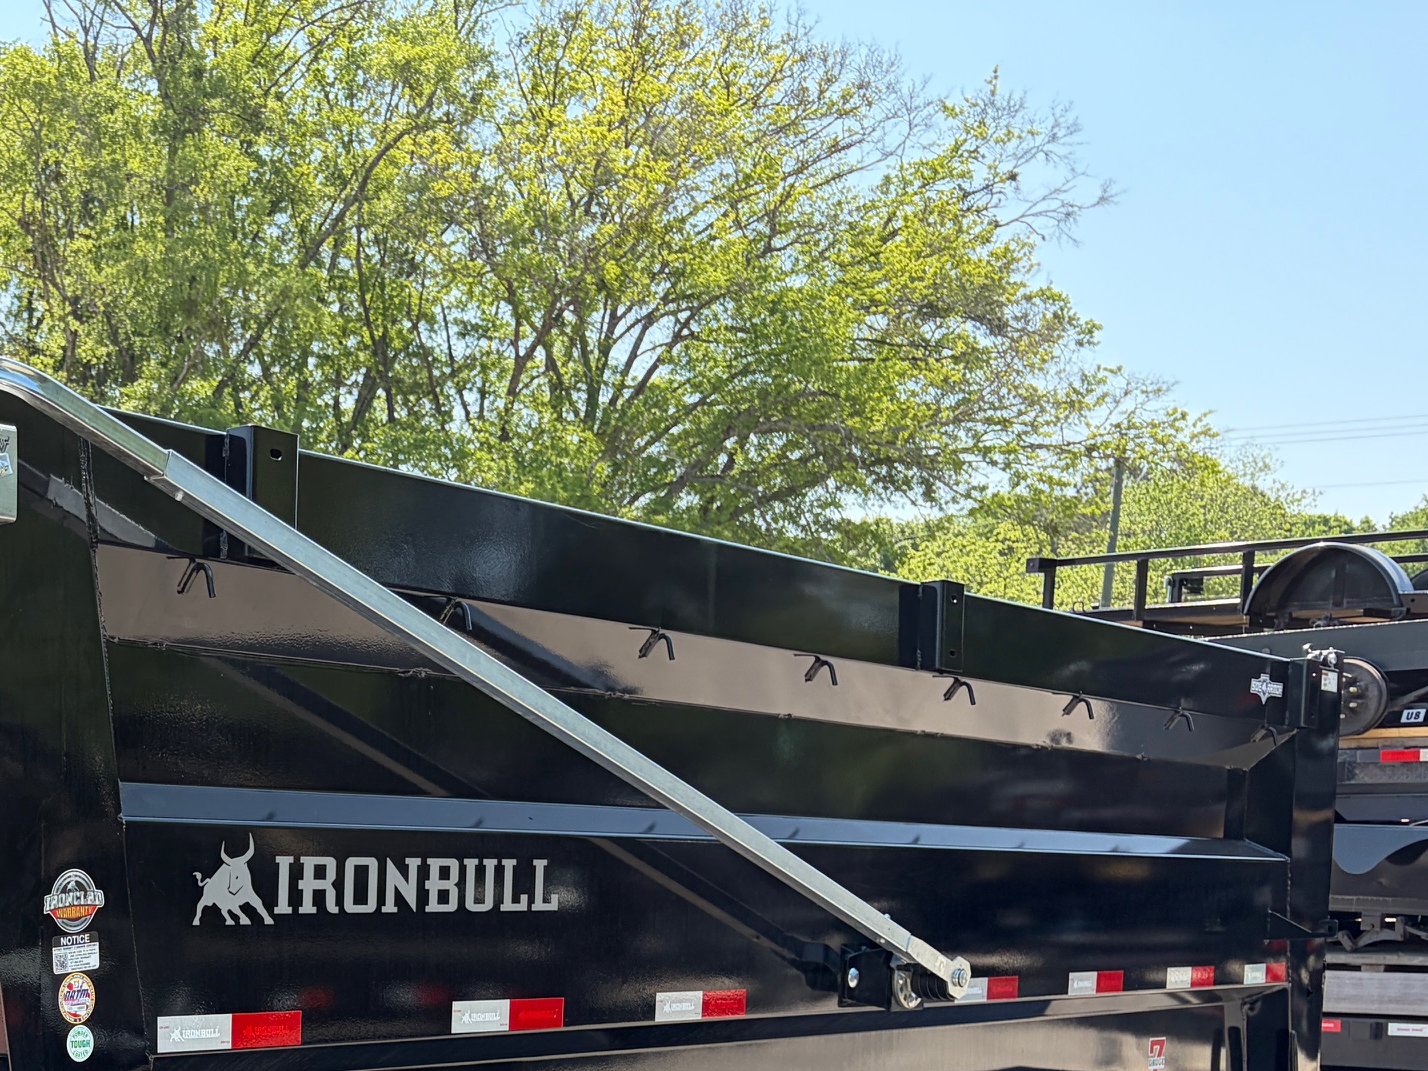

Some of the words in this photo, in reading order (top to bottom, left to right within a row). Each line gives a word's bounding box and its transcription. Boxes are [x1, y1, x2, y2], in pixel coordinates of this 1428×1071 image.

[274, 856, 558, 914] IRONBULL
[45, 890, 102, 911] IRONCLAD
[60, 934, 91, 946] NOTICE
[182, 1026, 220, 1038] IRONBULL
[71, 1040, 90, 1049] TOUGH
